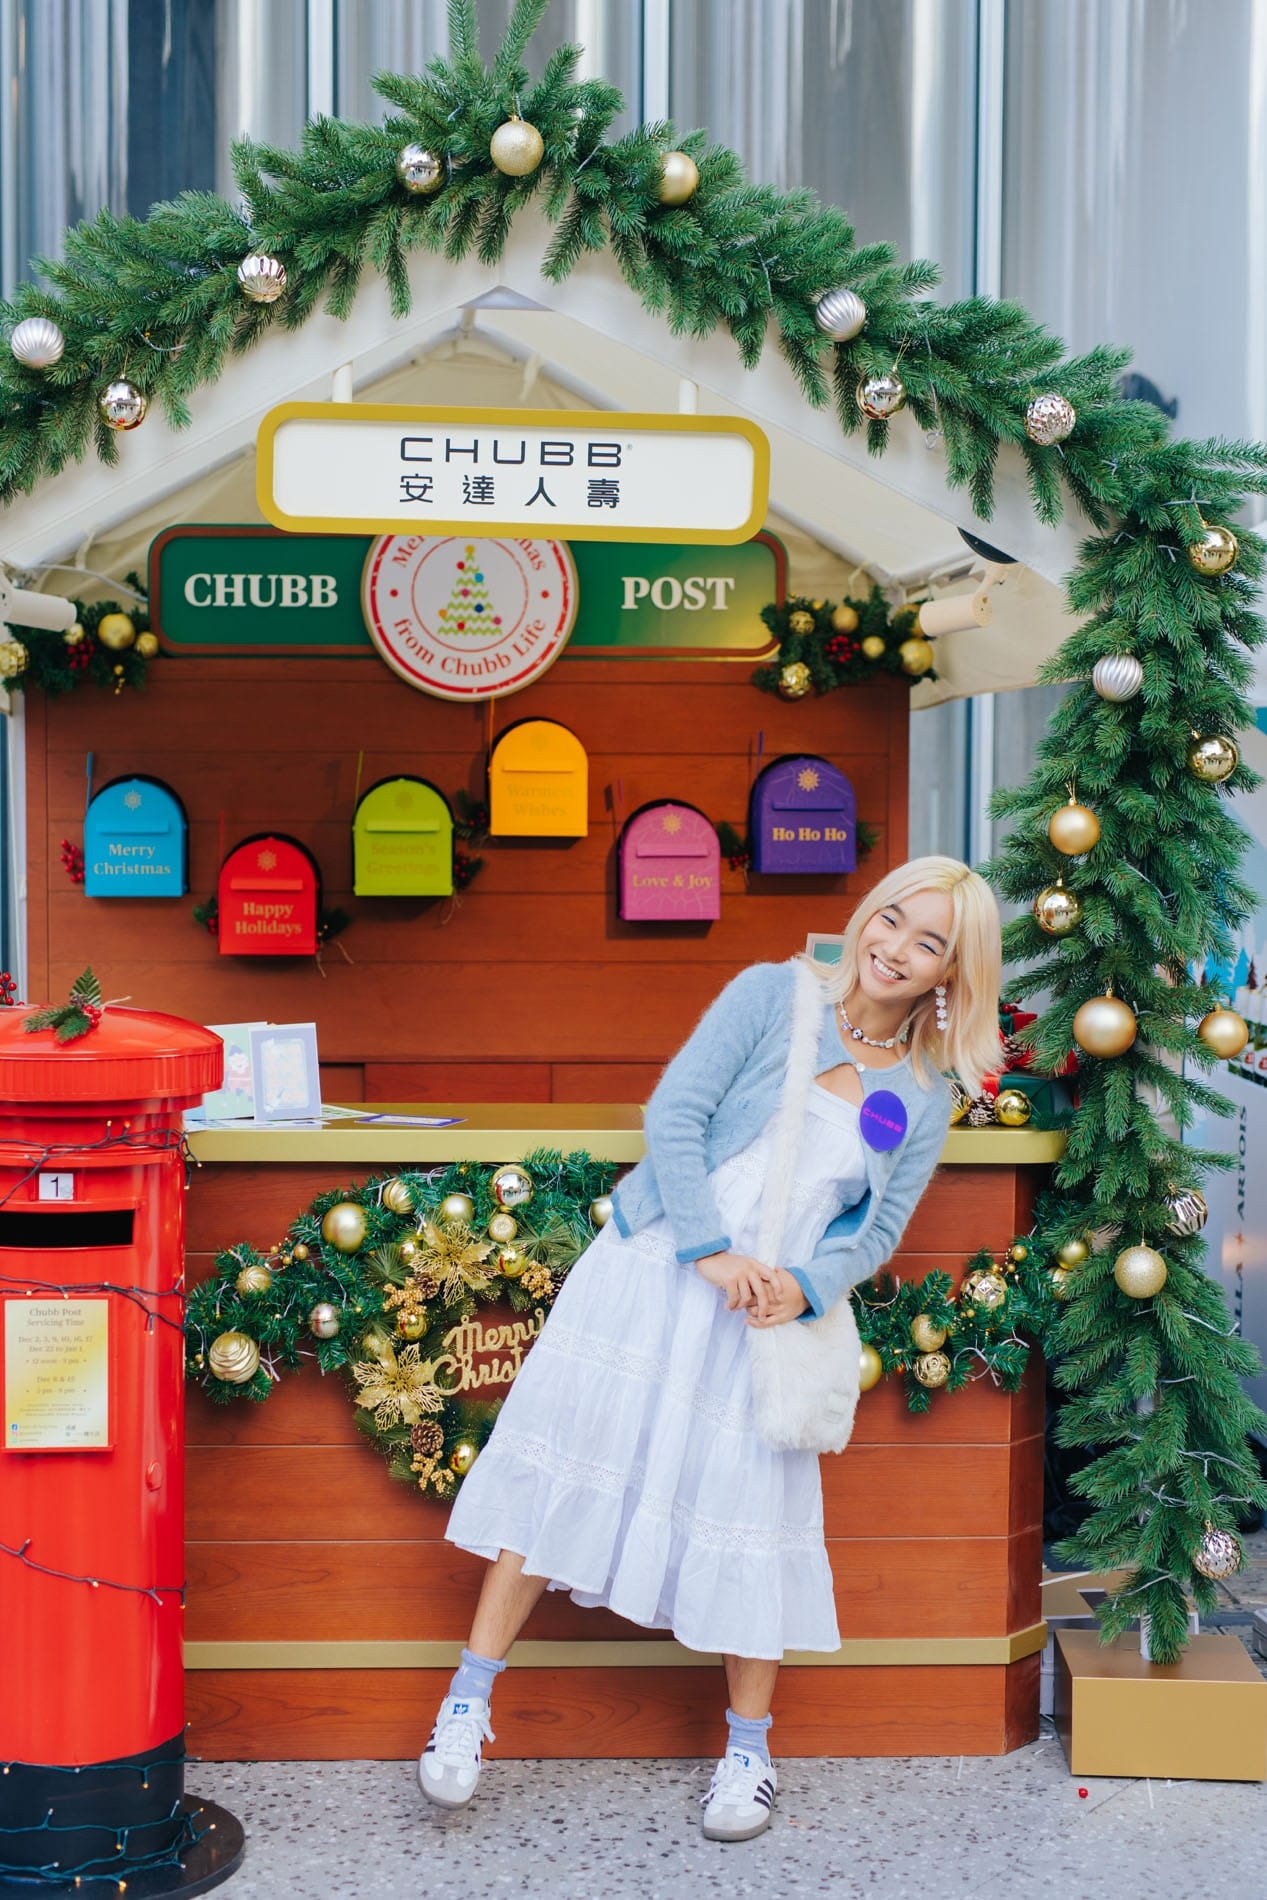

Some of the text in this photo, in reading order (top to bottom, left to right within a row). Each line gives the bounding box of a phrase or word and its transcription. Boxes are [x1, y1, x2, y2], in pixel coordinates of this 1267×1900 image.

[399, 473, 620, 509] 安達人壽
[183, 572, 736, 611] CHUBB POST
[393, 618, 547, 677] from Chubb Life
[772, 827, 847, 841] Ho Ho Ho
[108, 843, 156, 860] Merry
[93, 862, 172, 876] Christmas
[632, 873, 713, 892] Love & Joy
[242, 901, 295, 919] Happy
[234, 919, 303, 938] Holidays
[50, 1176, 59, 1198] 1
[29, 1308, 60, 1316] Chubb
[442, 1308, 545, 1359] Merry
